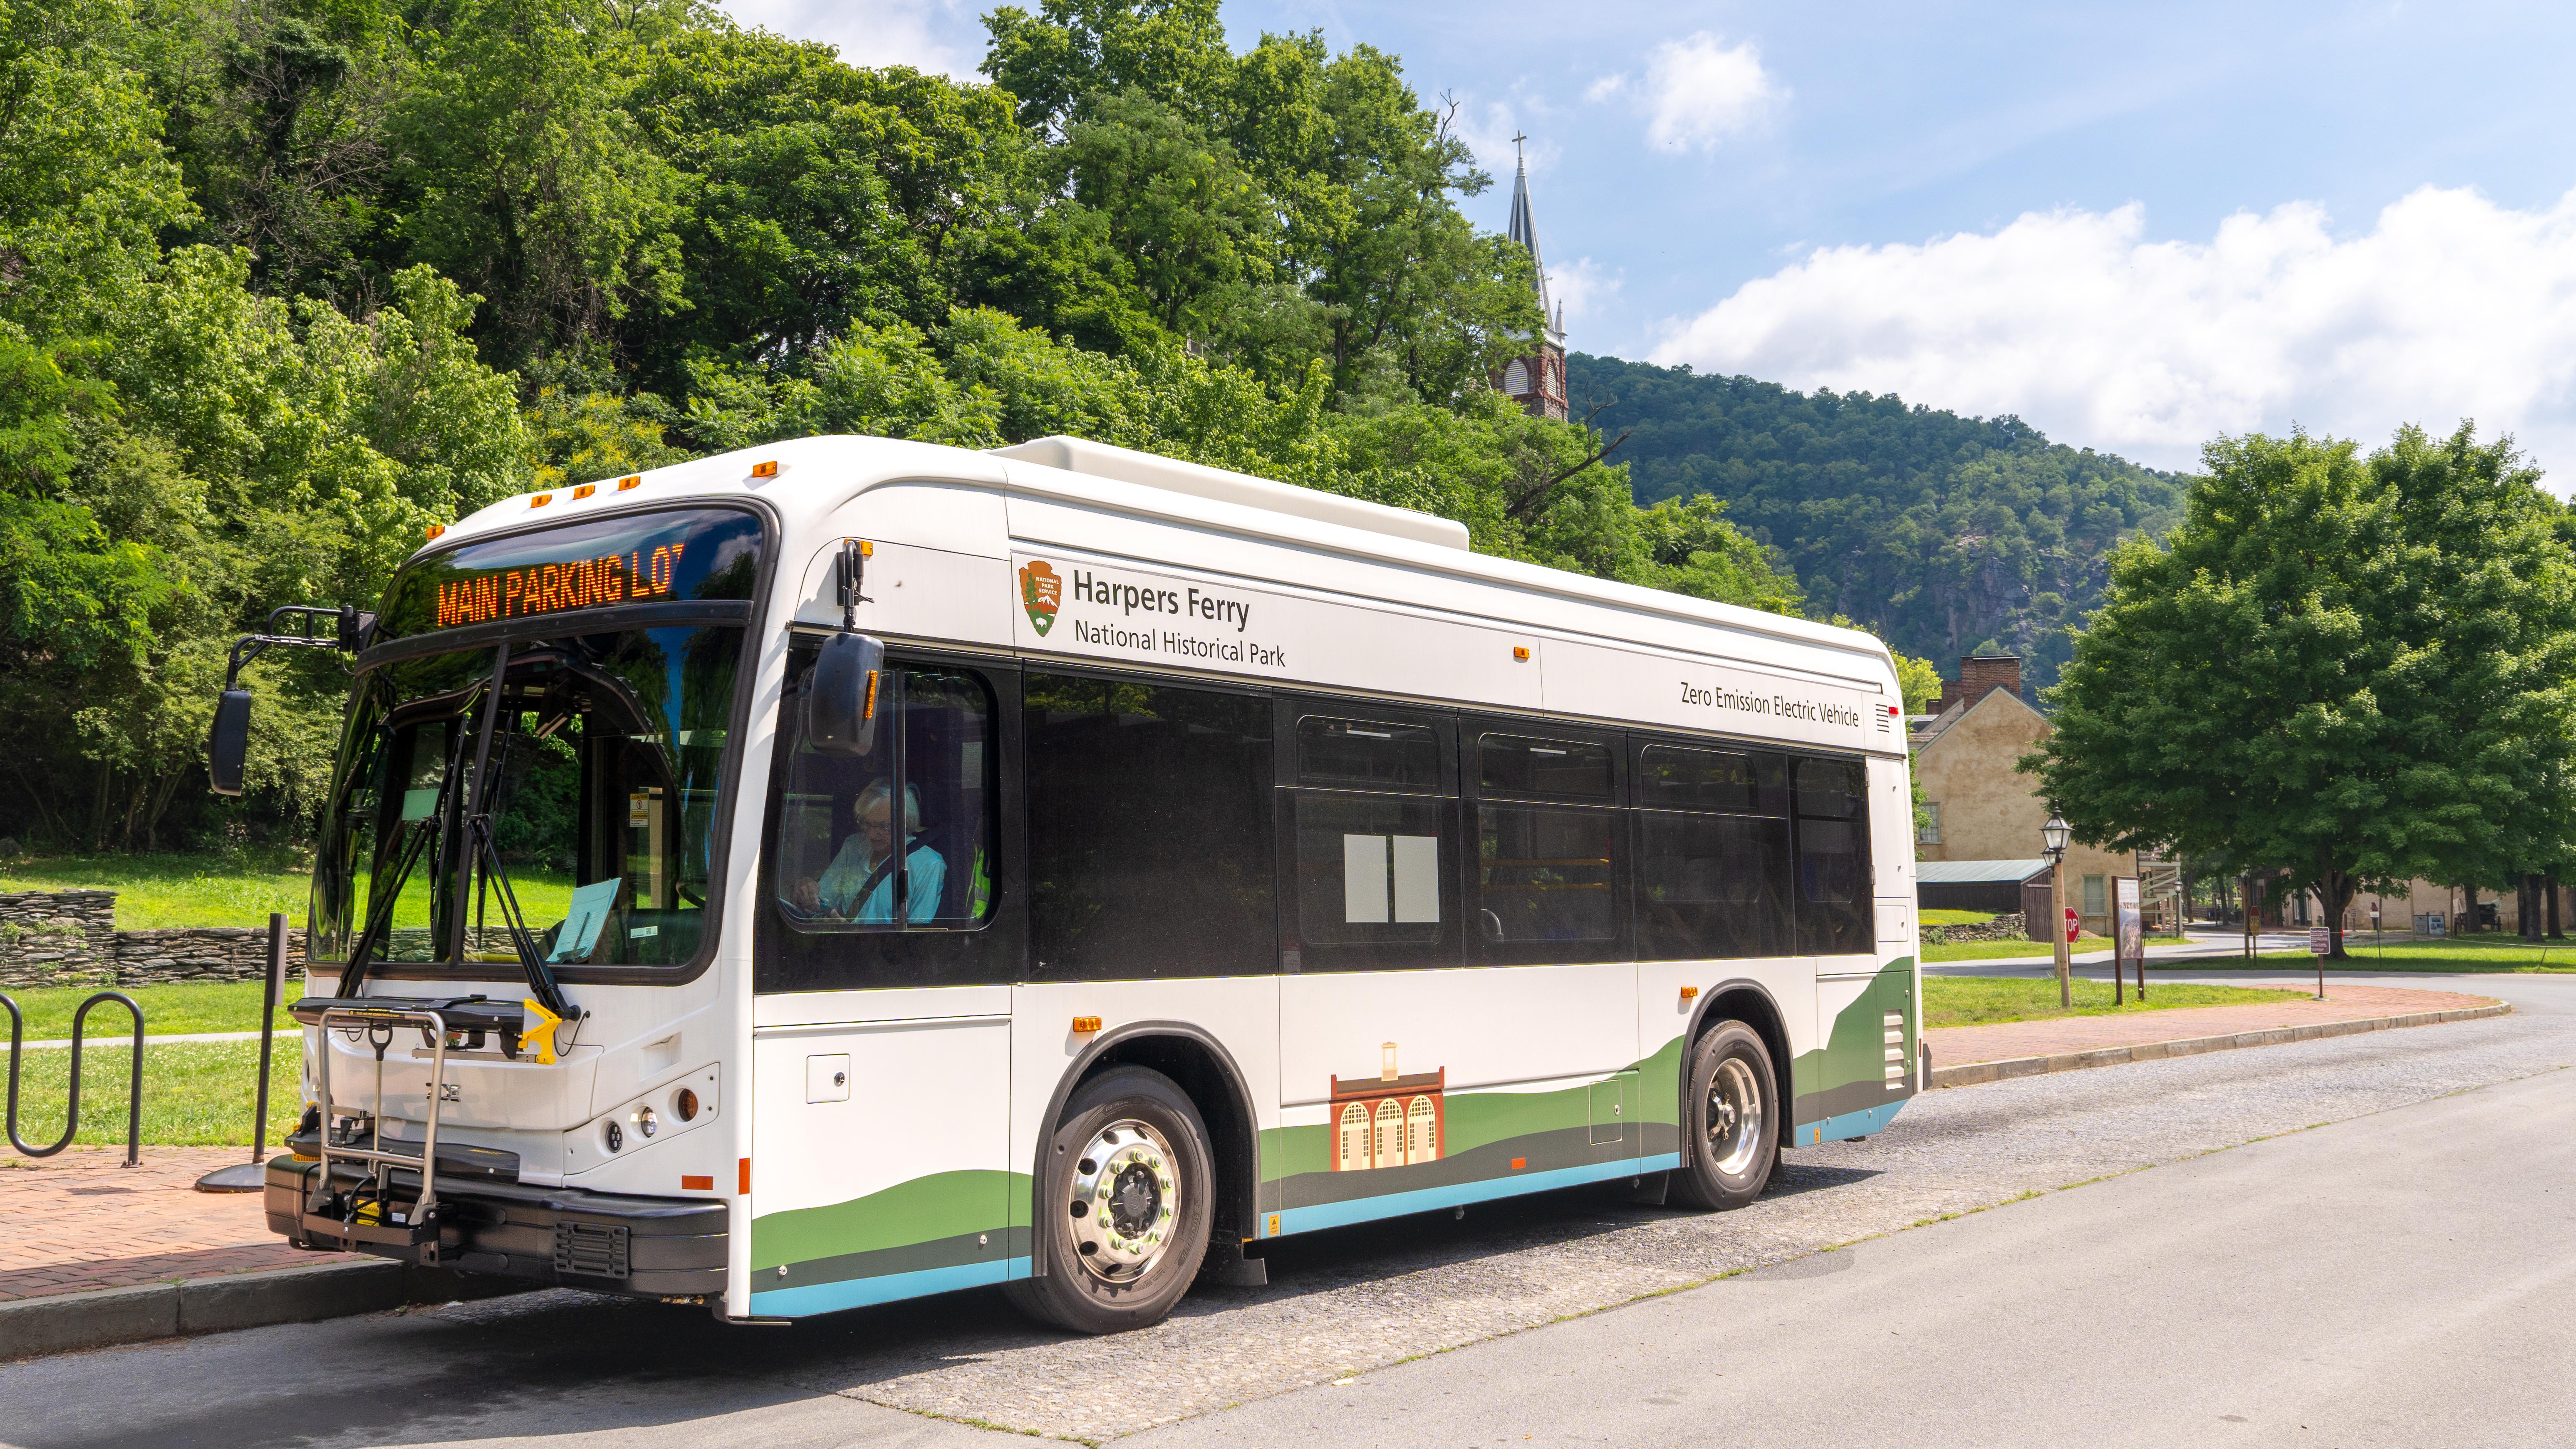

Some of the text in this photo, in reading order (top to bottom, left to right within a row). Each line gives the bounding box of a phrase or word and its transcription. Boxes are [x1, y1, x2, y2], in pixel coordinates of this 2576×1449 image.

[438, 575, 498, 626] MAIN
[506, 555, 622, 616] PARKING
[1074, 570, 1250, 632] Harpers Ferry
[1075, 619, 1286, 667] National Historical Park
[1681, 681, 1858, 727] Zero Emission Electric Vehicle
[2251, 916, 2260, 926] STOP
